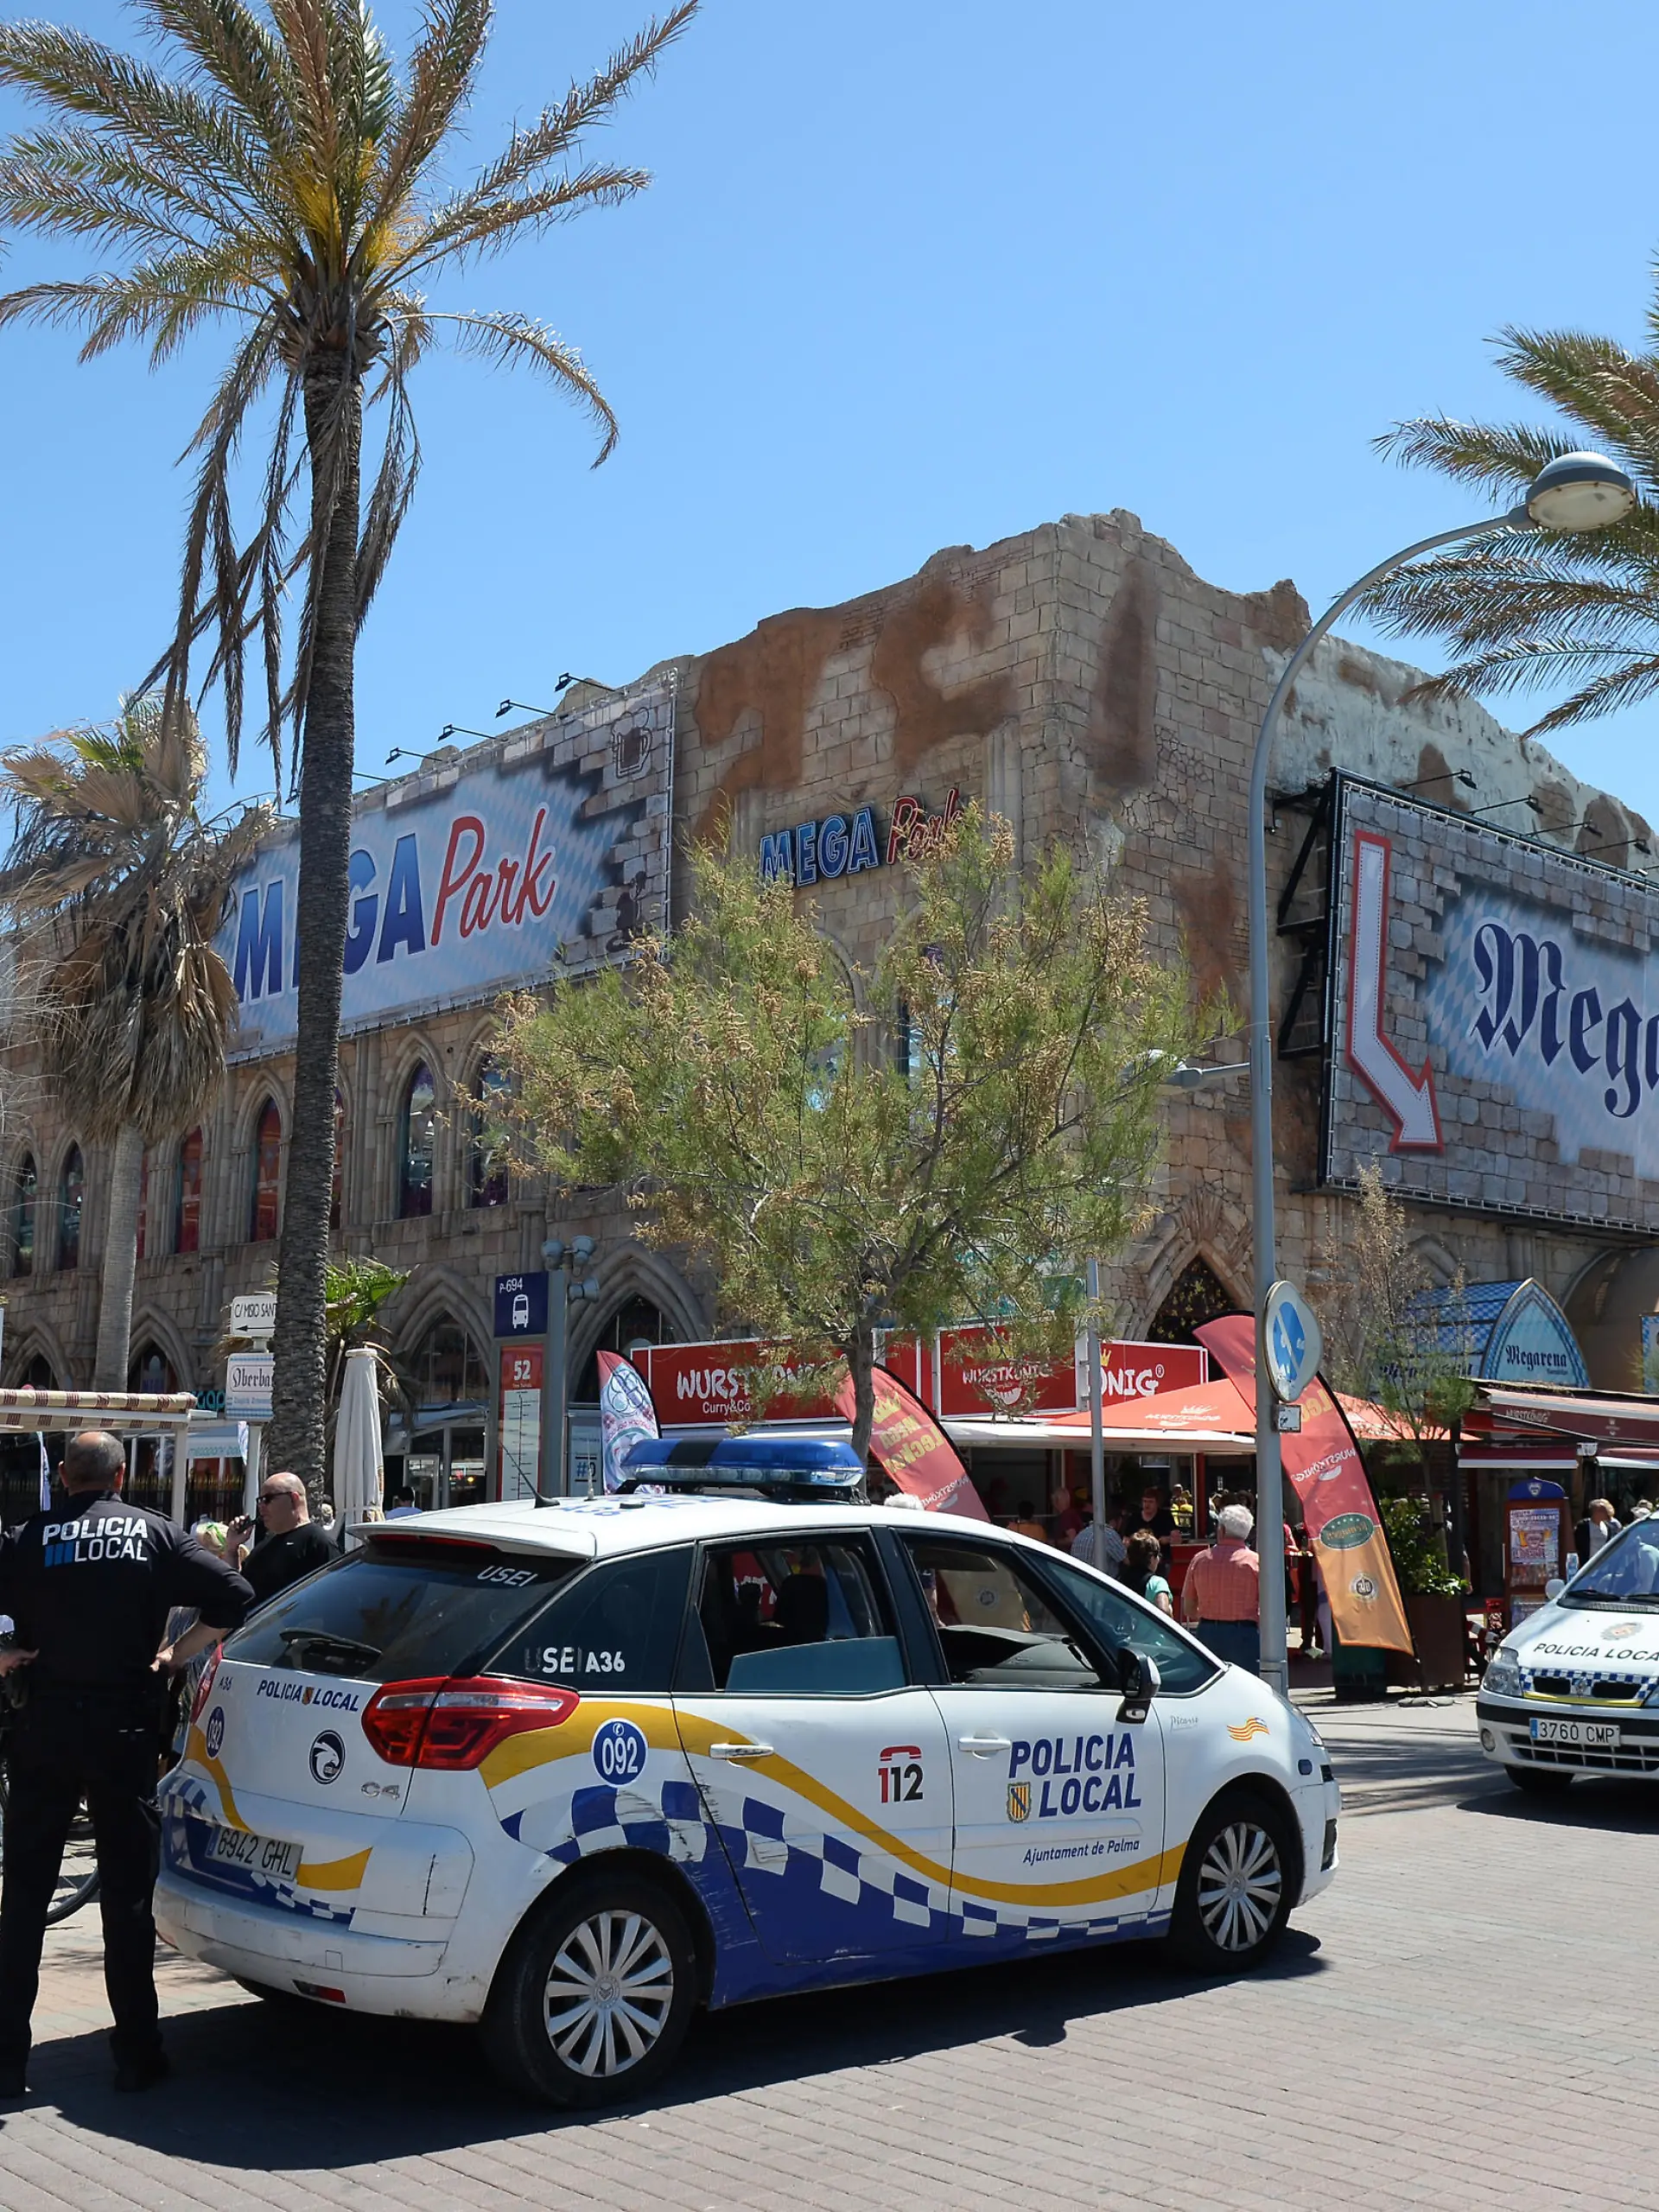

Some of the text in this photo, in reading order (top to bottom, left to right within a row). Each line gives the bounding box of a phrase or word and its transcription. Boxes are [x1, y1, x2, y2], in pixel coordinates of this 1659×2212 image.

[760, 807, 879, 887] MEGA
[235, 808, 556, 1004] MGA Park
[499, 1277, 523, 1294] P-694
[513, 1359, 531, 1381] 52
[1505, 1344, 1567, 1371] Megarena
[232, 1368, 273, 1387] Oberba
[42, 1516, 149, 1546] POLICIA
[73, 1537, 149, 1563] LOCAL
[477, 1566, 538, 1587] USEI
[585, 1650, 626, 1673] A36
[1533, 1643, 1659, 1662] POLICIA LOCA
[257, 1679, 359, 1713] POLICIA LOCAL
[207, 1718, 224, 1751] 092
[1539, 1721, 1615, 1743] 3760 CMP
[601, 1736, 639, 1777] 092
[1008, 1732, 1135, 1779] POLICIA
[360, 1781, 401, 1801] C4
[878, 1763, 924, 1803] 112
[1039, 1772, 1142, 1818] LOCAL
[217, 1827, 292, 1876] 6942 GHL
[1022, 1839, 1141, 1866] Ajuntament de Palma
